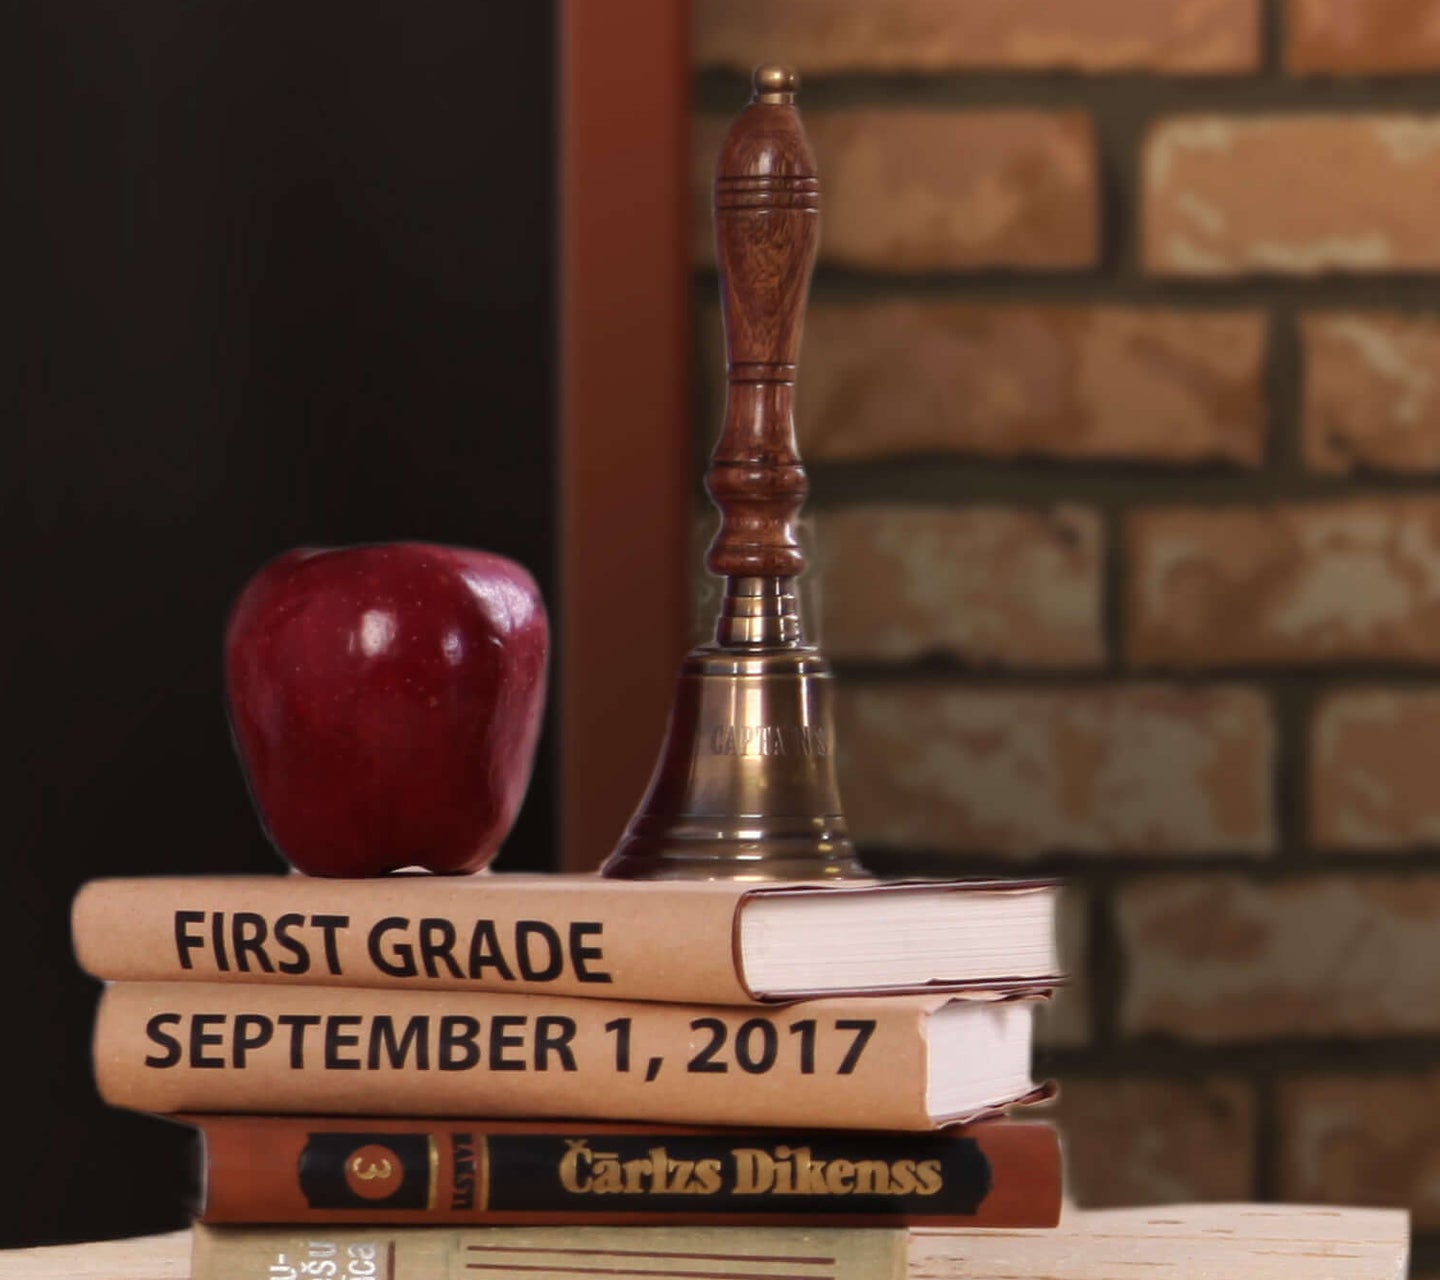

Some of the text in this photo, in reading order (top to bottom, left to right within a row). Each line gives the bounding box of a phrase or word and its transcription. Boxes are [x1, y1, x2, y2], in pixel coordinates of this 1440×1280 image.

[174, 910, 613, 984] FIRST GRADE
[145, 1013, 877, 1081] SEPTEMBER 1, 2017
[351, 1156, 392, 1180] 3
[558, 1139, 943, 1195] Čārlzs Dikenss
